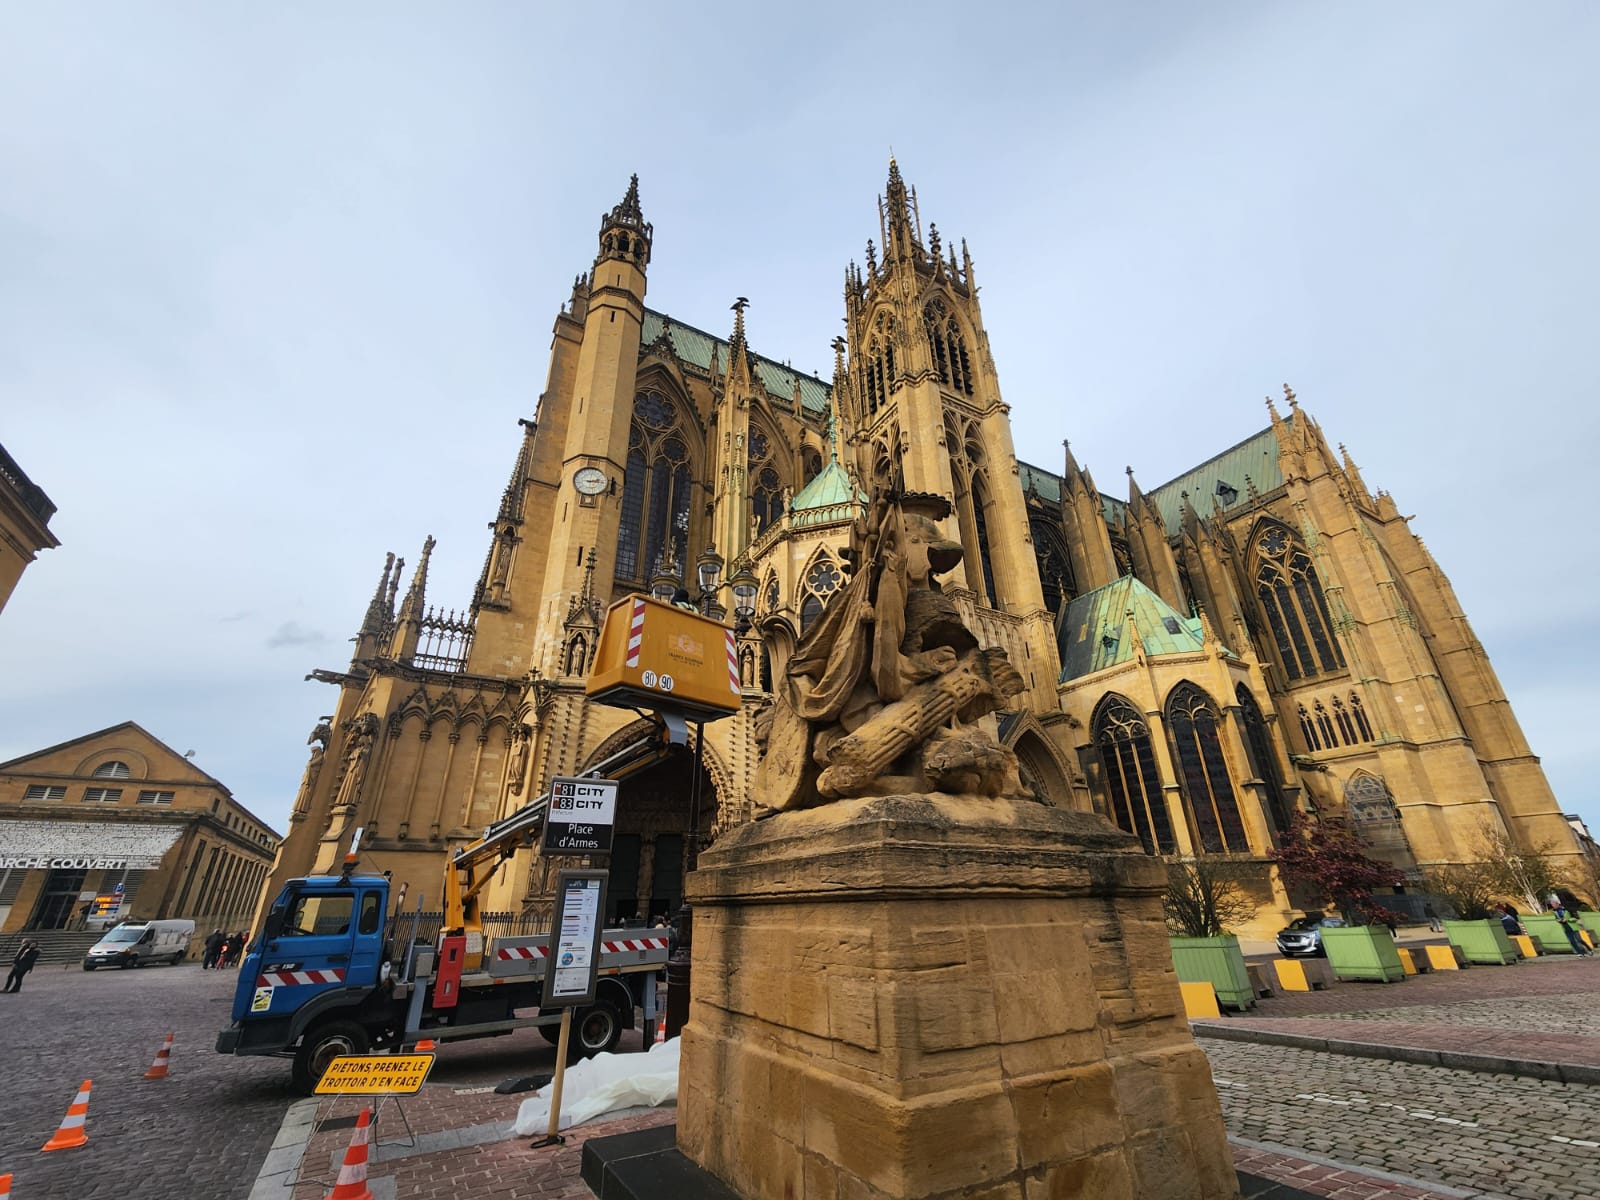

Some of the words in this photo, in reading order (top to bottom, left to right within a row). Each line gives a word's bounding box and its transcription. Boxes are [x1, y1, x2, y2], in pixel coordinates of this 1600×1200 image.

[645, 672, 654, 686] 80
[662, 676, 672, 690] 90
[561, 785, 573, 796] 81
[577, 788, 605, 796] CITY
[559, 798, 573, 809] 83
[575, 800, 603, 809] CITY
[568, 823, 593, 834] Place
[558, 836, 599, 848] d'Armes
[50, 858, 126, 869] COUVERT
[372, 1062, 411, 1072] PRENEZ
[412, 1061, 426, 1072] LE
[322, 1077, 368, 1088] TROTTOIR
[369, 1076, 393, 1087] D'EN
[393, 1076, 420, 1086] FACE
